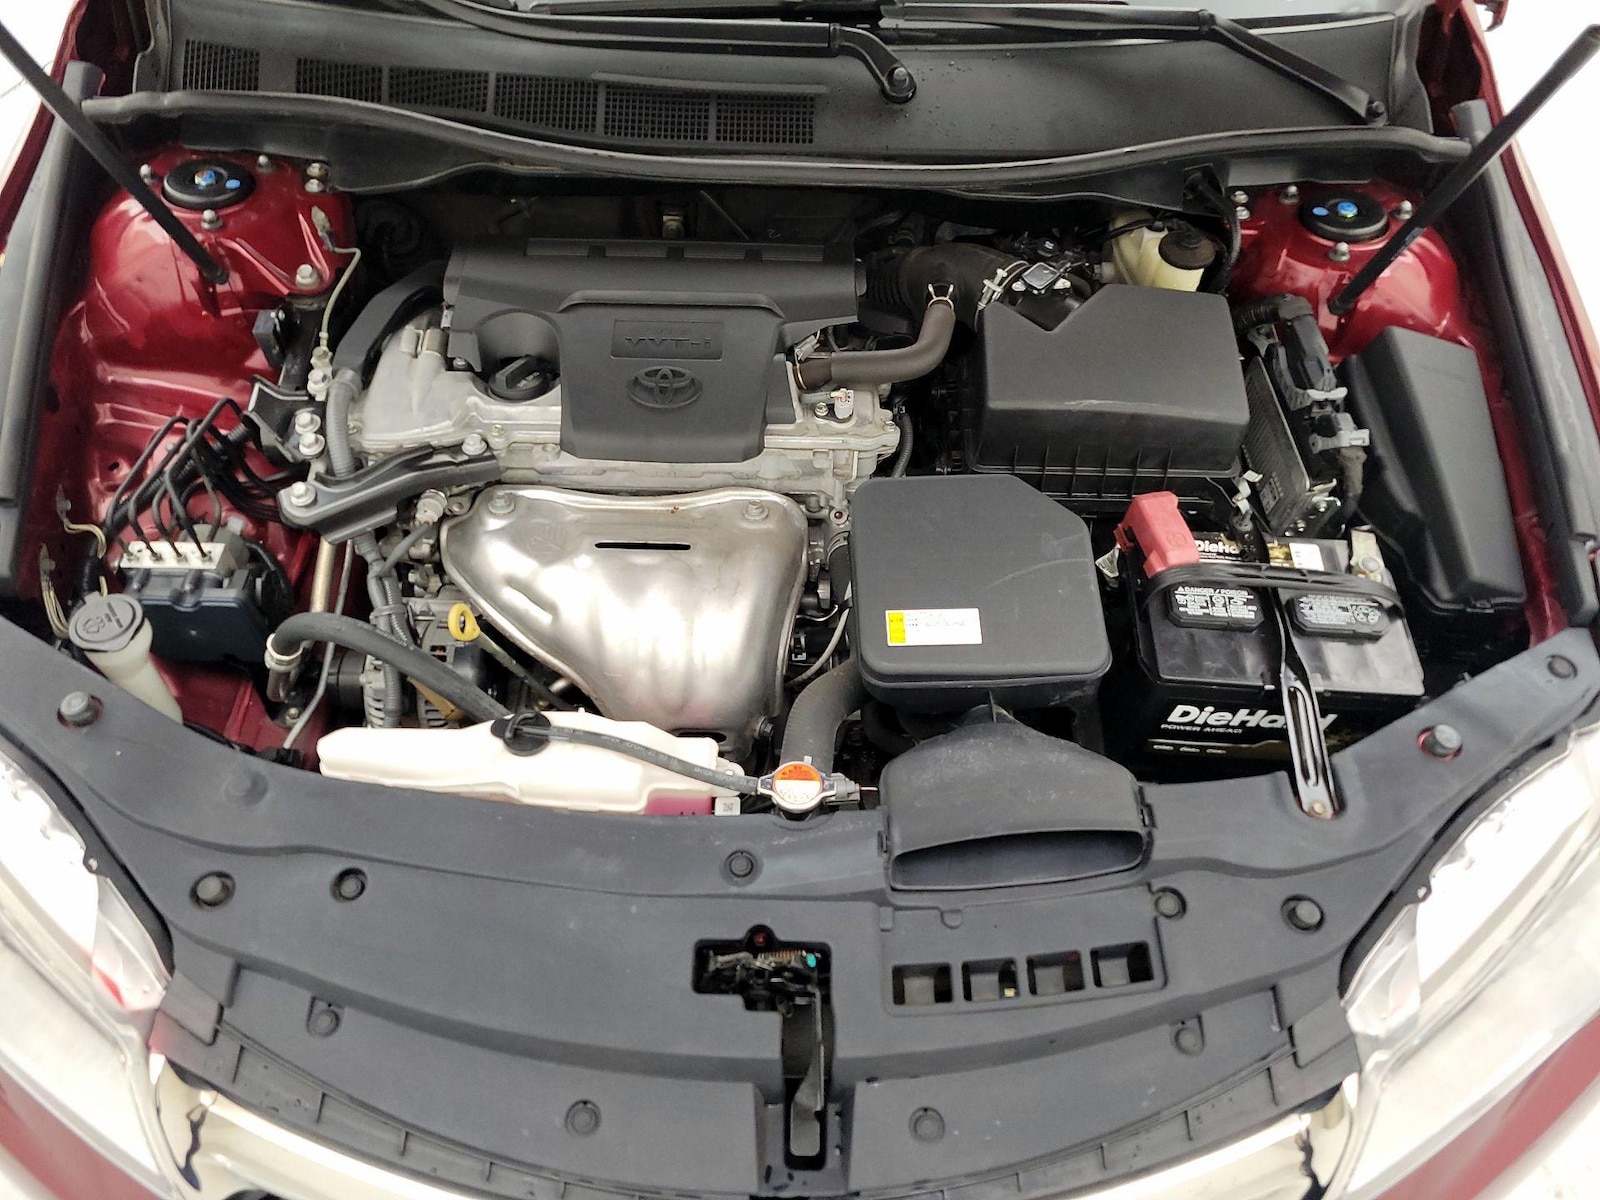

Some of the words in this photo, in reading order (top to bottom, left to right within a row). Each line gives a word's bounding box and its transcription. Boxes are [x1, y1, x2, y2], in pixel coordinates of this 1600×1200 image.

[1194, 539, 1240, 555] DieHa
[1166, 704, 1338, 731] DieHa
[1160, 722, 1202, 732] POWER
[1202, 726, 1243, 734] AHEAD
